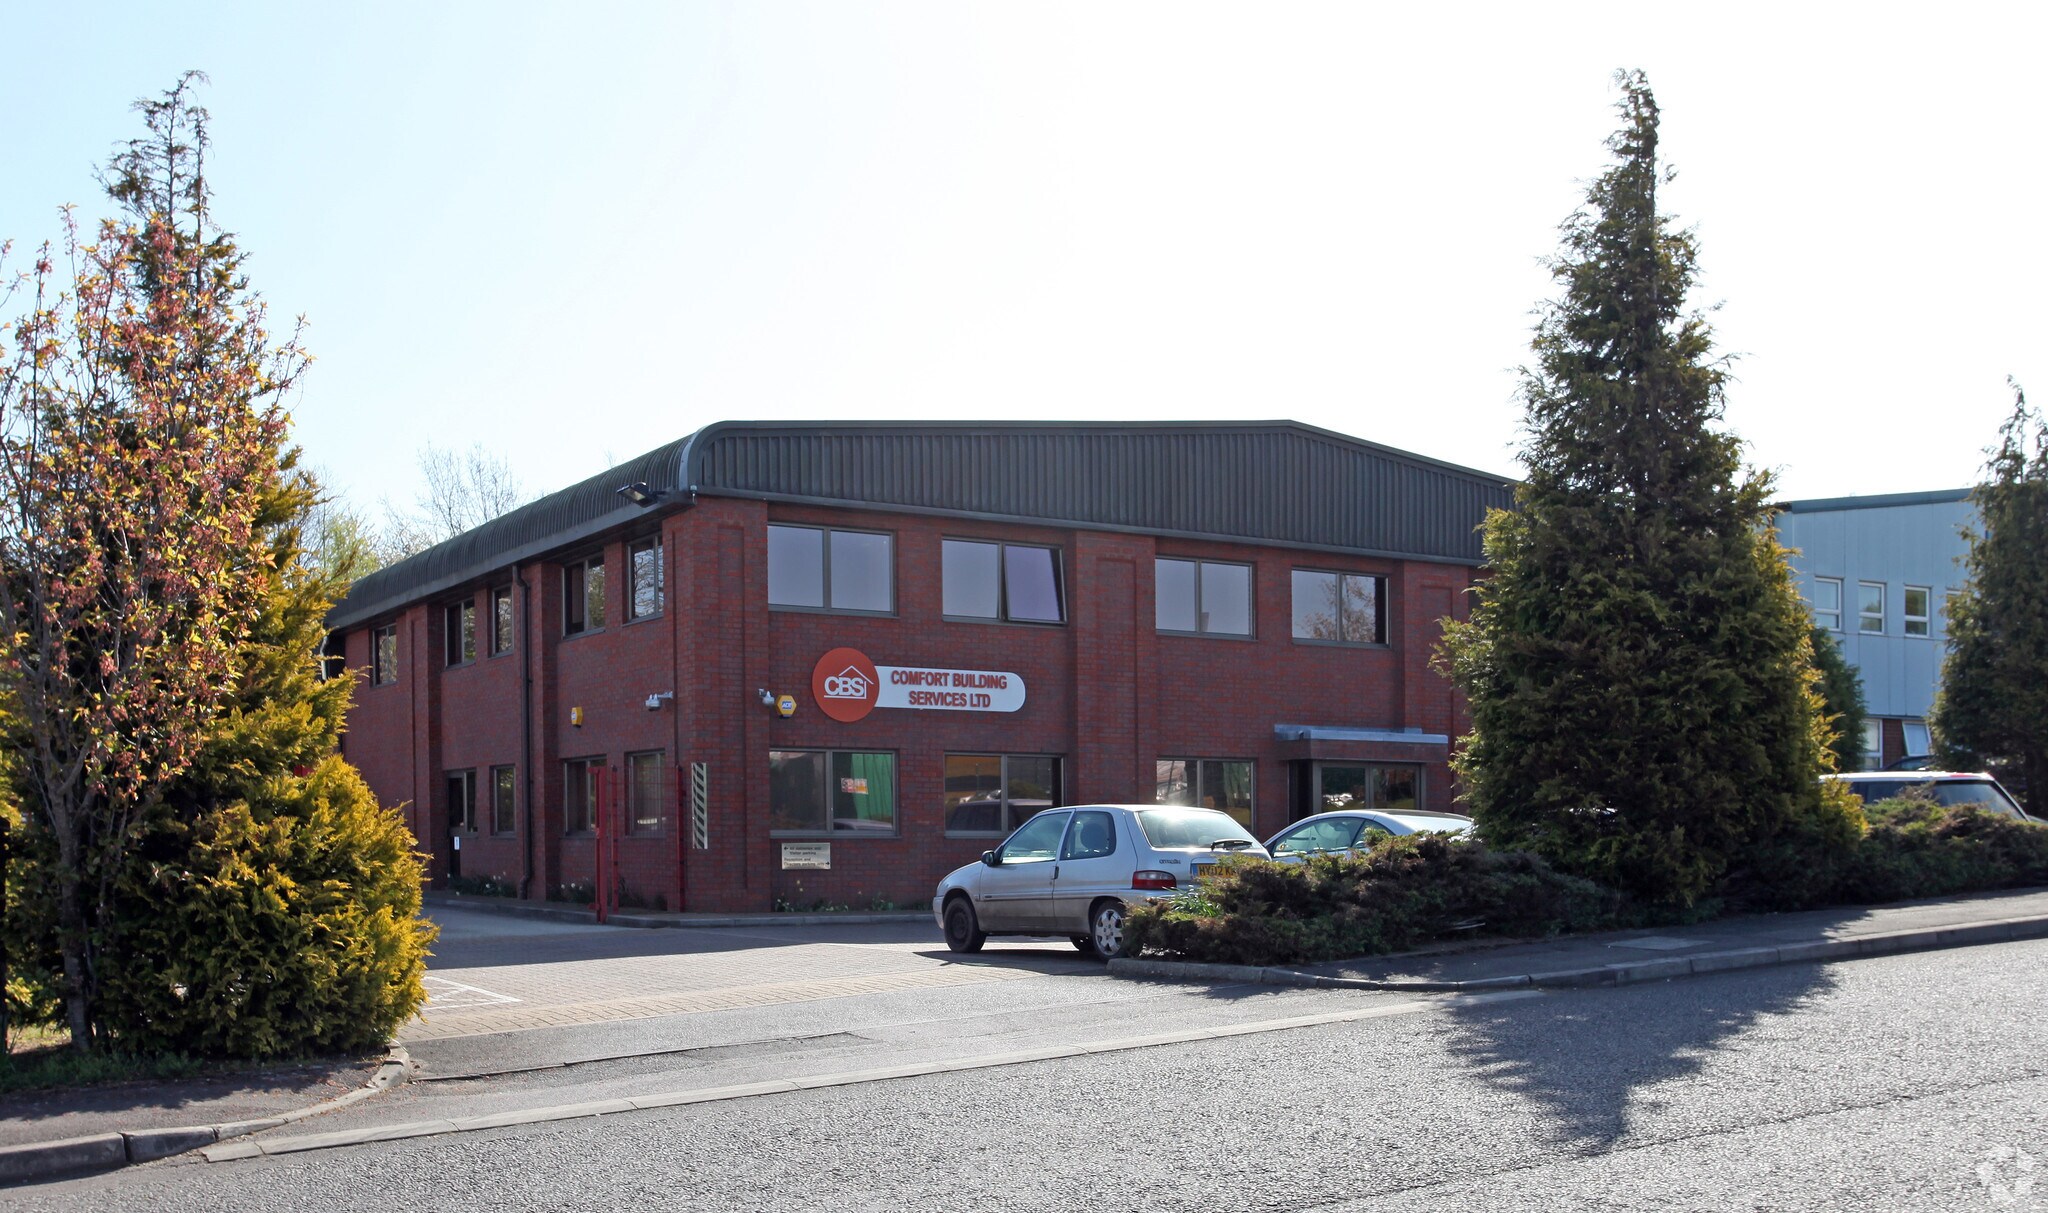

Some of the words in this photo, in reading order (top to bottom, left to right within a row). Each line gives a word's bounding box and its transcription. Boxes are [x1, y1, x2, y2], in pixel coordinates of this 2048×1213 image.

[825, 676, 864, 696] CBS
[891, 670, 949, 687] COMFORT
[952, 673, 1007, 689] BUILDING
[909, 690, 967, 707] SERVICES
[970, 693, 991, 708] LTD
